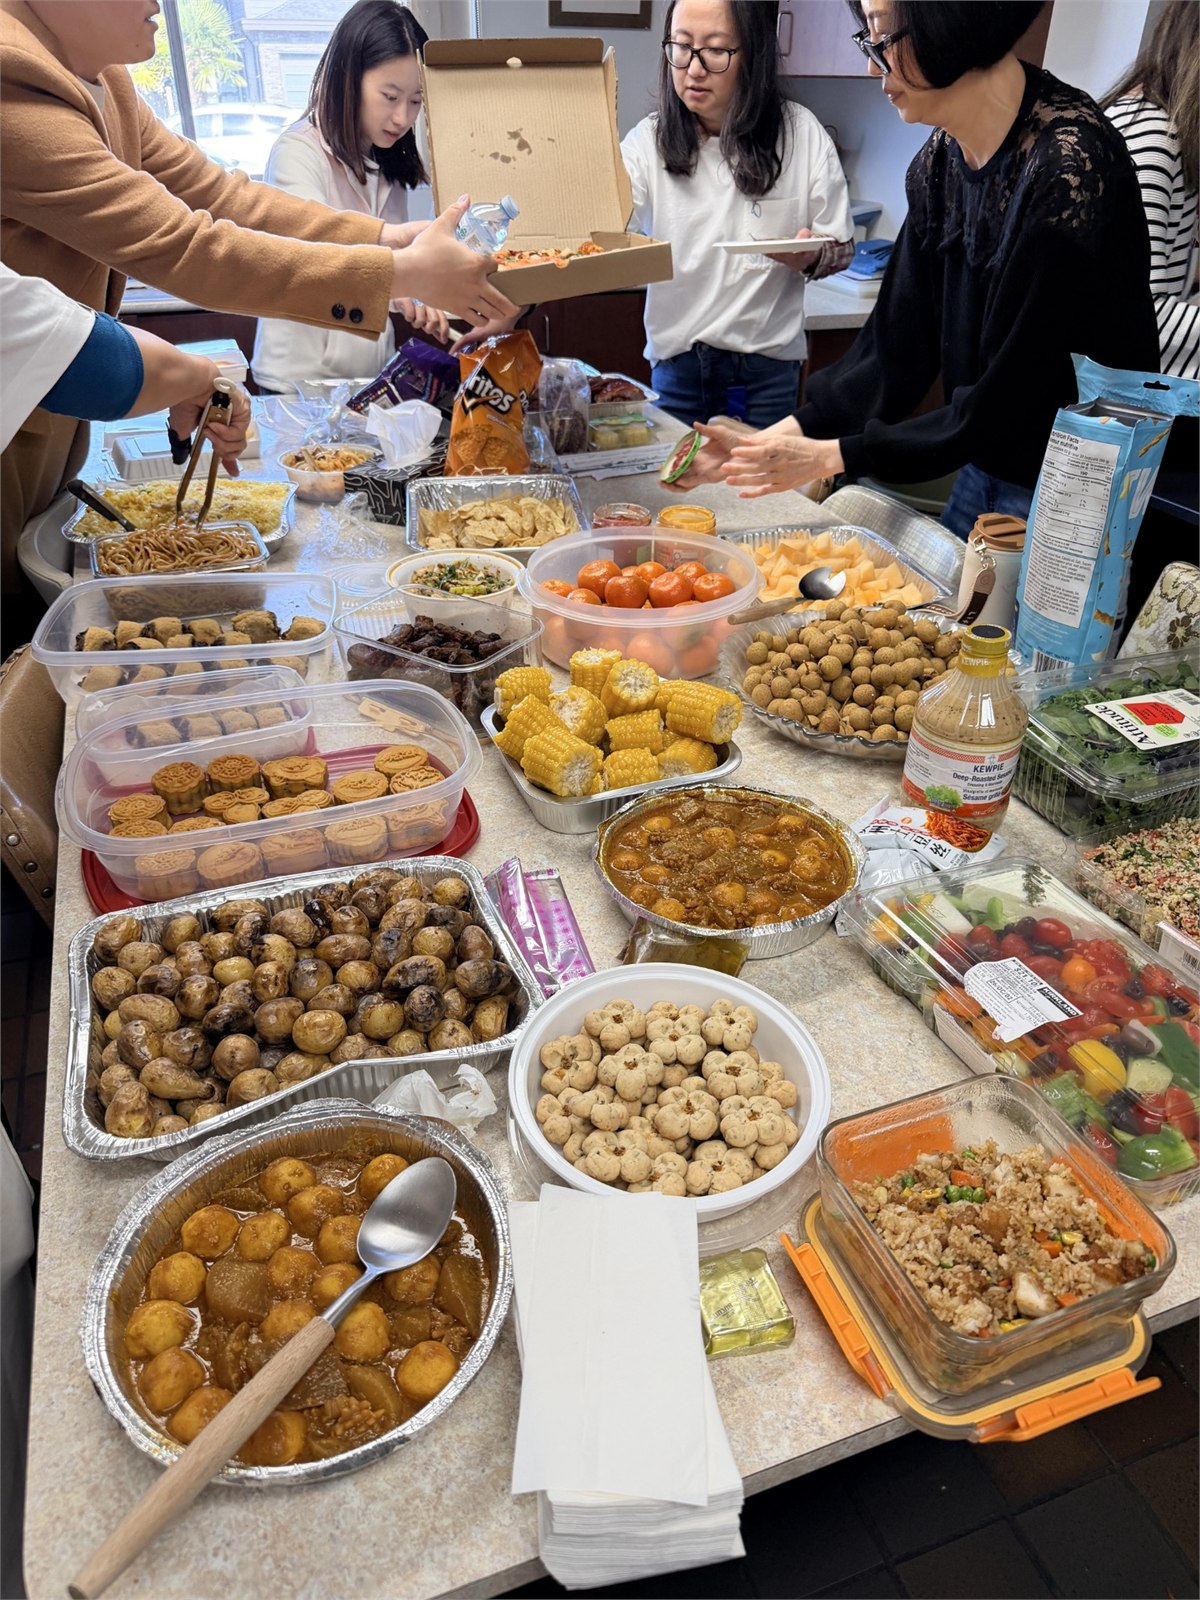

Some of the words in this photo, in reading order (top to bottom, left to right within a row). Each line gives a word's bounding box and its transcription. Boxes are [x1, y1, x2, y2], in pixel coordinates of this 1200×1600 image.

[468, 376, 516, 412] ritos
[1095, 704, 1157, 746] Attitude
[952, 772, 996, 782] Deep-Roasted
[973, 763, 1005, 773] KEWPIE
[962, 793, 988, 801] Sésame
[1042, 987, 1078, 1016] KIRKLAND
